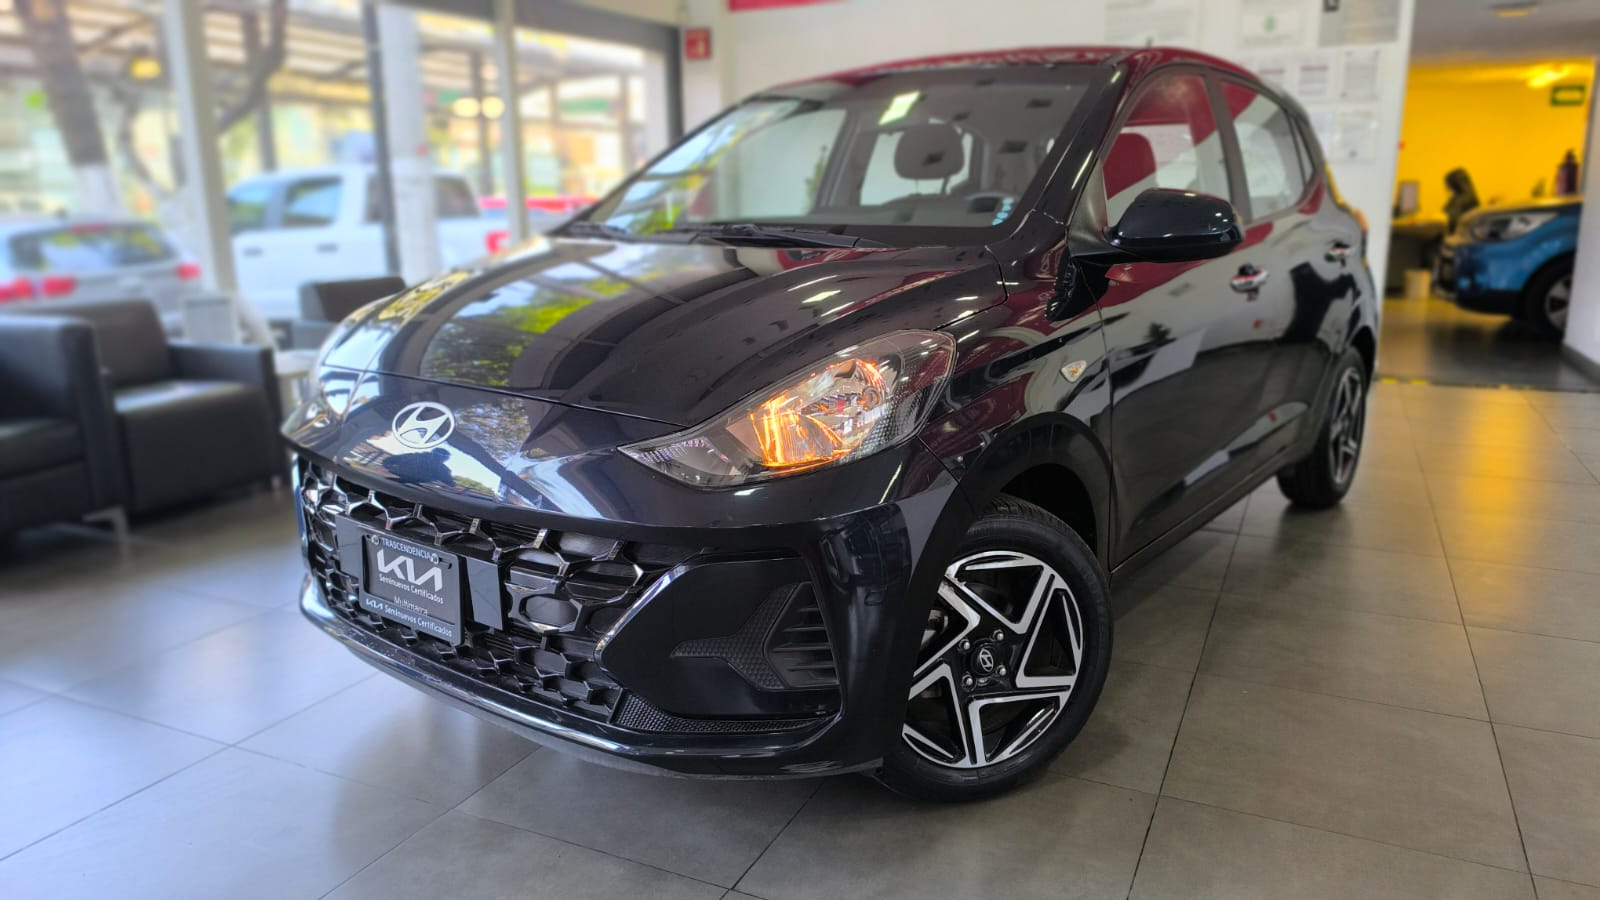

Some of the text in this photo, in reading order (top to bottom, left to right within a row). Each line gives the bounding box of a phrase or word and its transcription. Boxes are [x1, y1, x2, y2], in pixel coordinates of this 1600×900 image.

[381, 537, 431, 560] TRASCENDENCIA
[377, 549, 443, 592] KIA
[379, 573, 444, 604] Seminuevos Certificados
[366, 598, 453, 638] KIA Seminuevos Certificados
